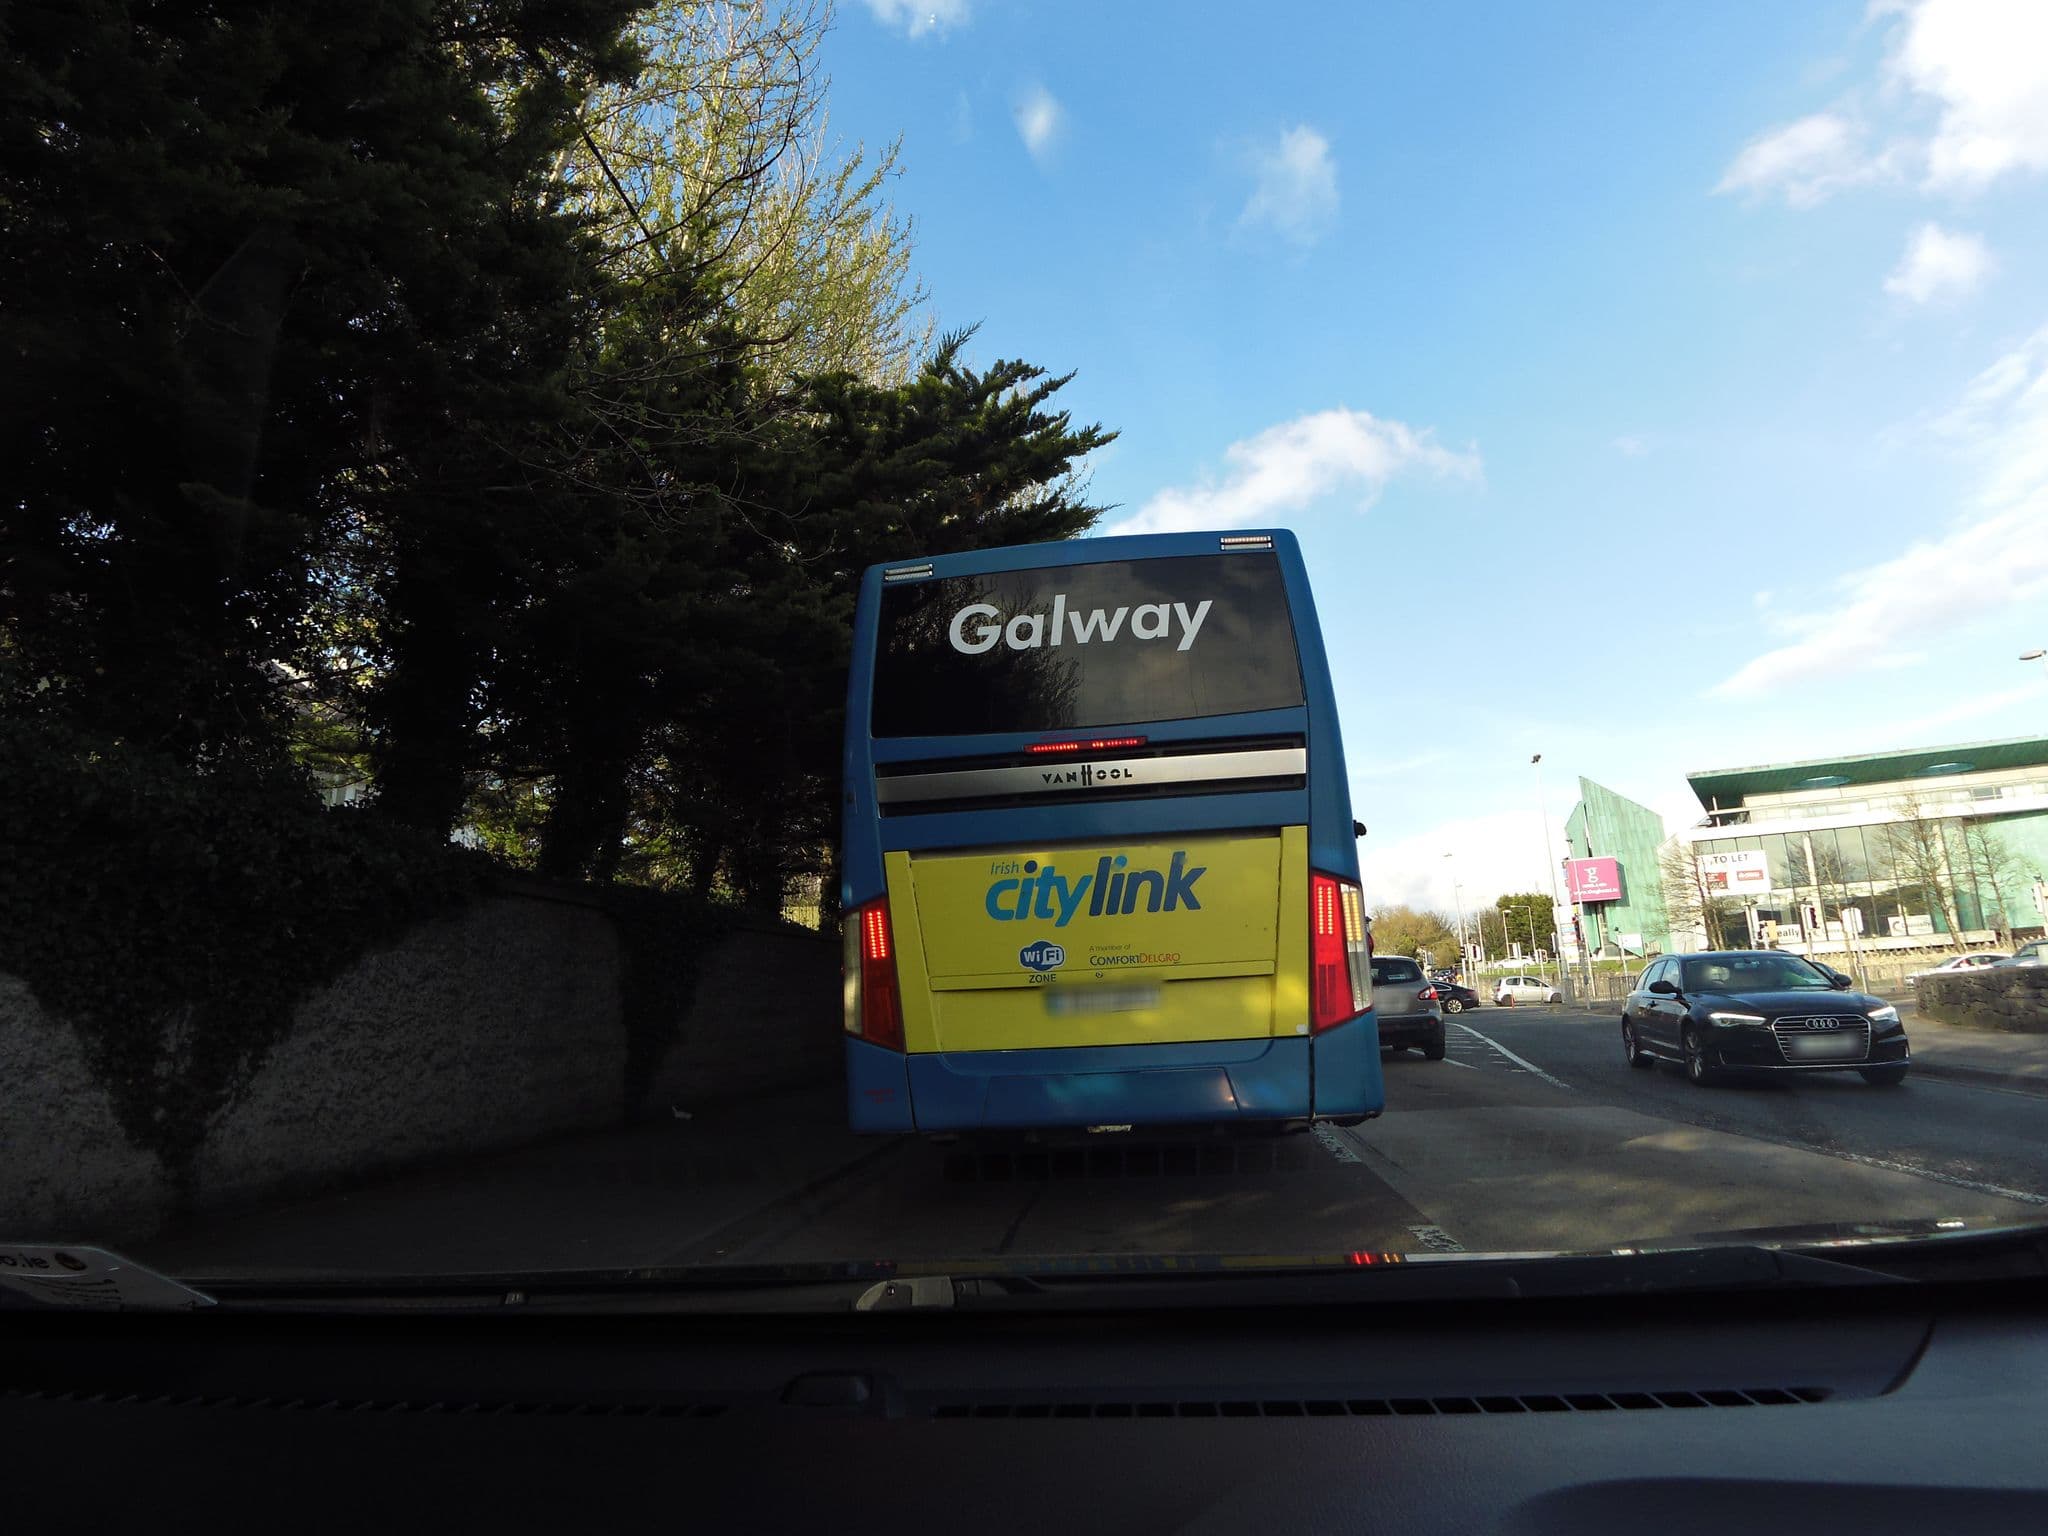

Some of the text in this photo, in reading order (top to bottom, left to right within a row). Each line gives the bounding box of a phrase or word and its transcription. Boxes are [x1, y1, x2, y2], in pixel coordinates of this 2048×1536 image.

[949, 594, 1213, 655] Galway
[1713, 853, 1748, 864] TO LET
[991, 862, 1019, 875] Irish
[985, 851, 1208, 927] citylink
[1029, 973, 1057, 984] ZONE
